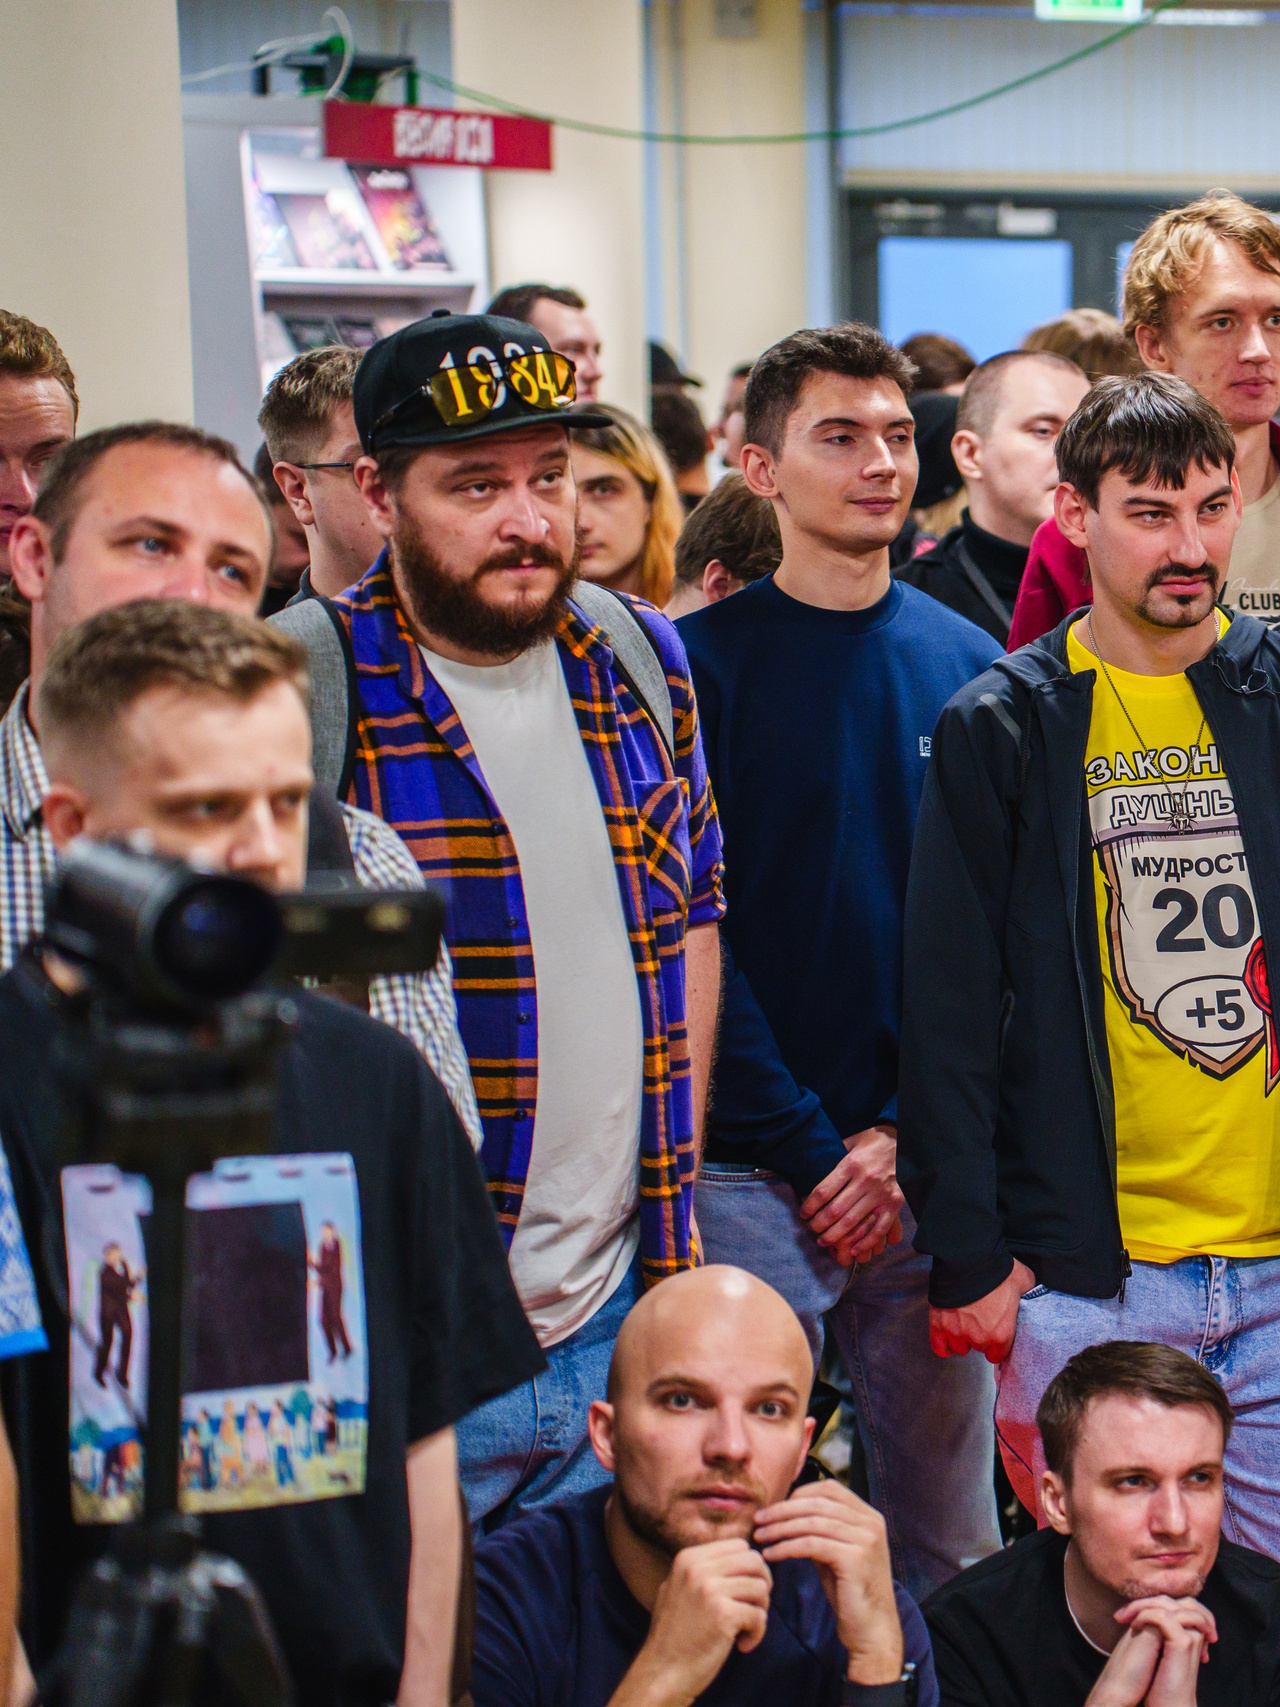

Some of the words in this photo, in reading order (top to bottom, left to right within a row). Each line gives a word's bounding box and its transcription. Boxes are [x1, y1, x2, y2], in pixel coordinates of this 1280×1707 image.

[439, 341, 559, 417] 1984
[1151, 883, 1255, 954] 20
[1185, 989, 1246, 1031] +5
